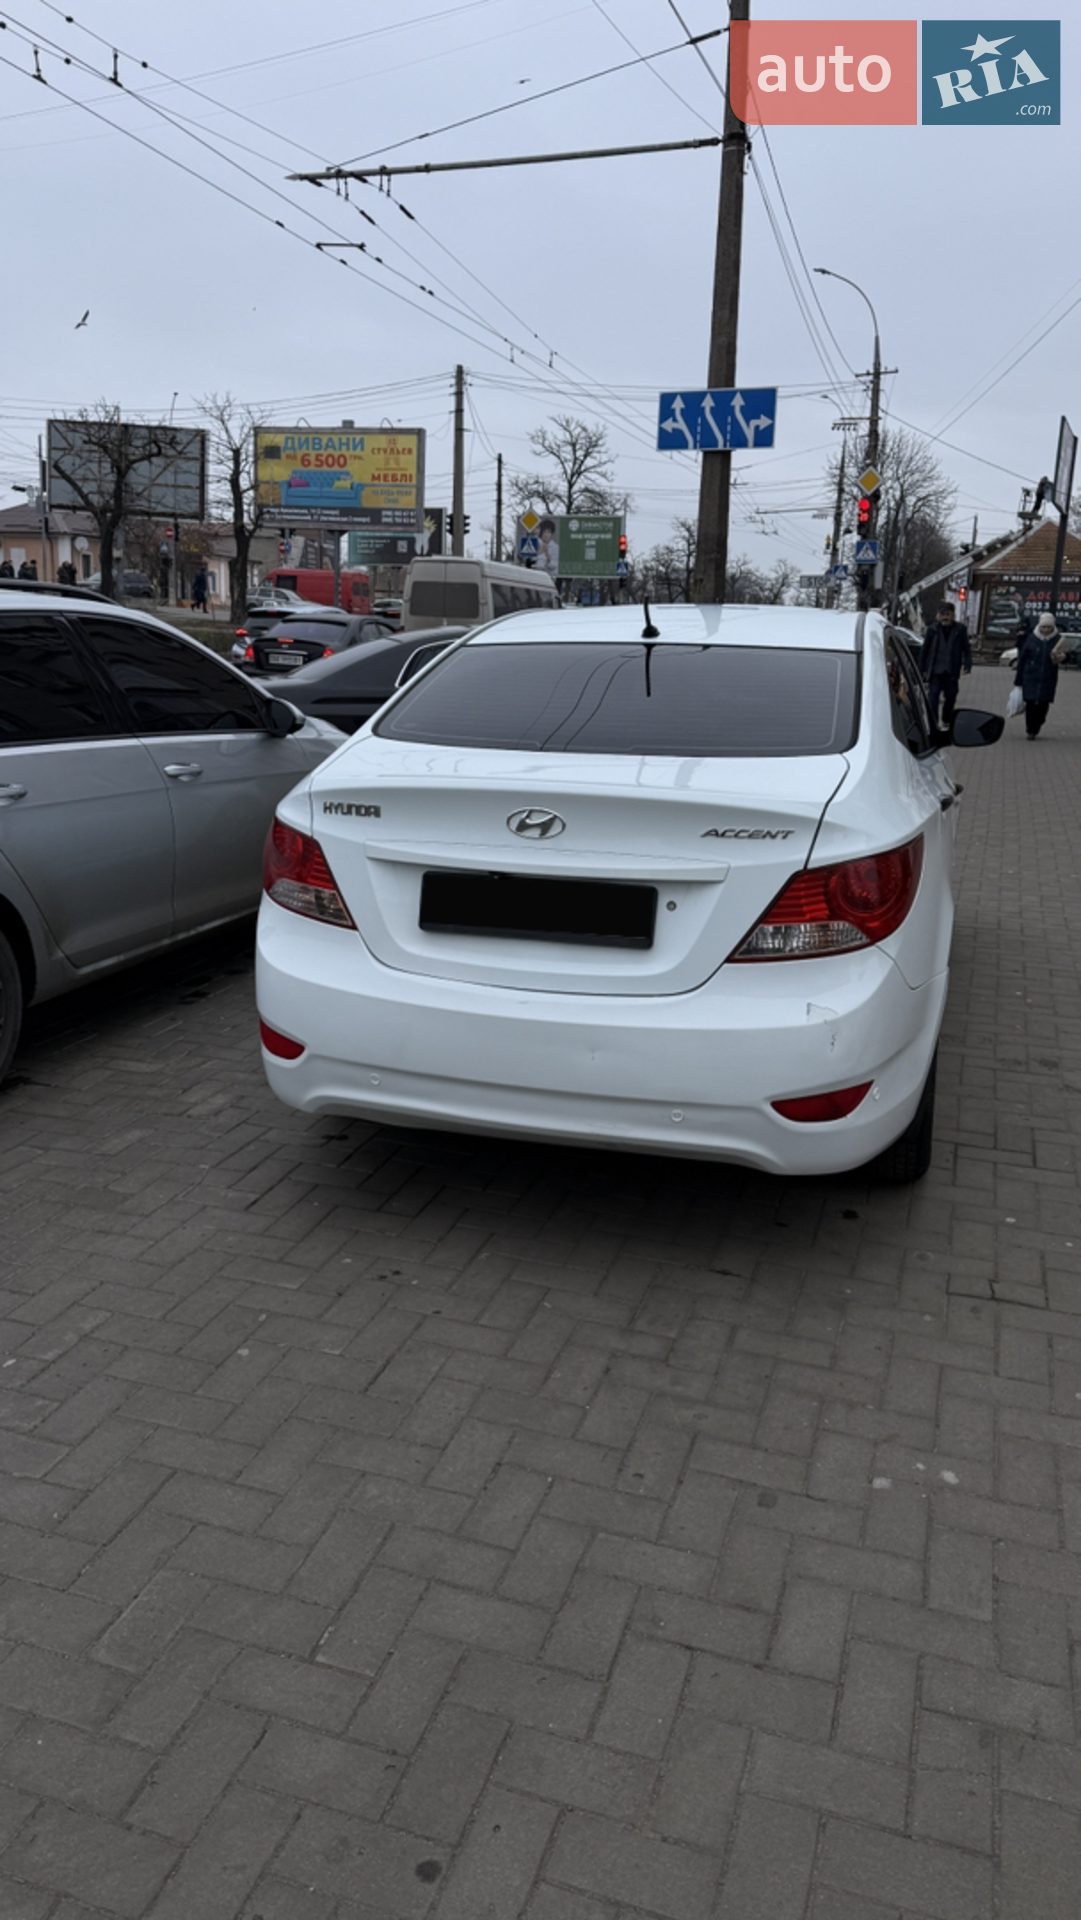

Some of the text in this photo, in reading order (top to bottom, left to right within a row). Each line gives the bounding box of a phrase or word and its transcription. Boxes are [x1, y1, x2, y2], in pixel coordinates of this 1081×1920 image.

[282, 436, 364, 452] ДИВАНИ
[371, 472, 413, 483] МЕБЛІ
[323, 801, 381, 819] HYUNDAI
[700, 828, 795, 840] ACCENT
